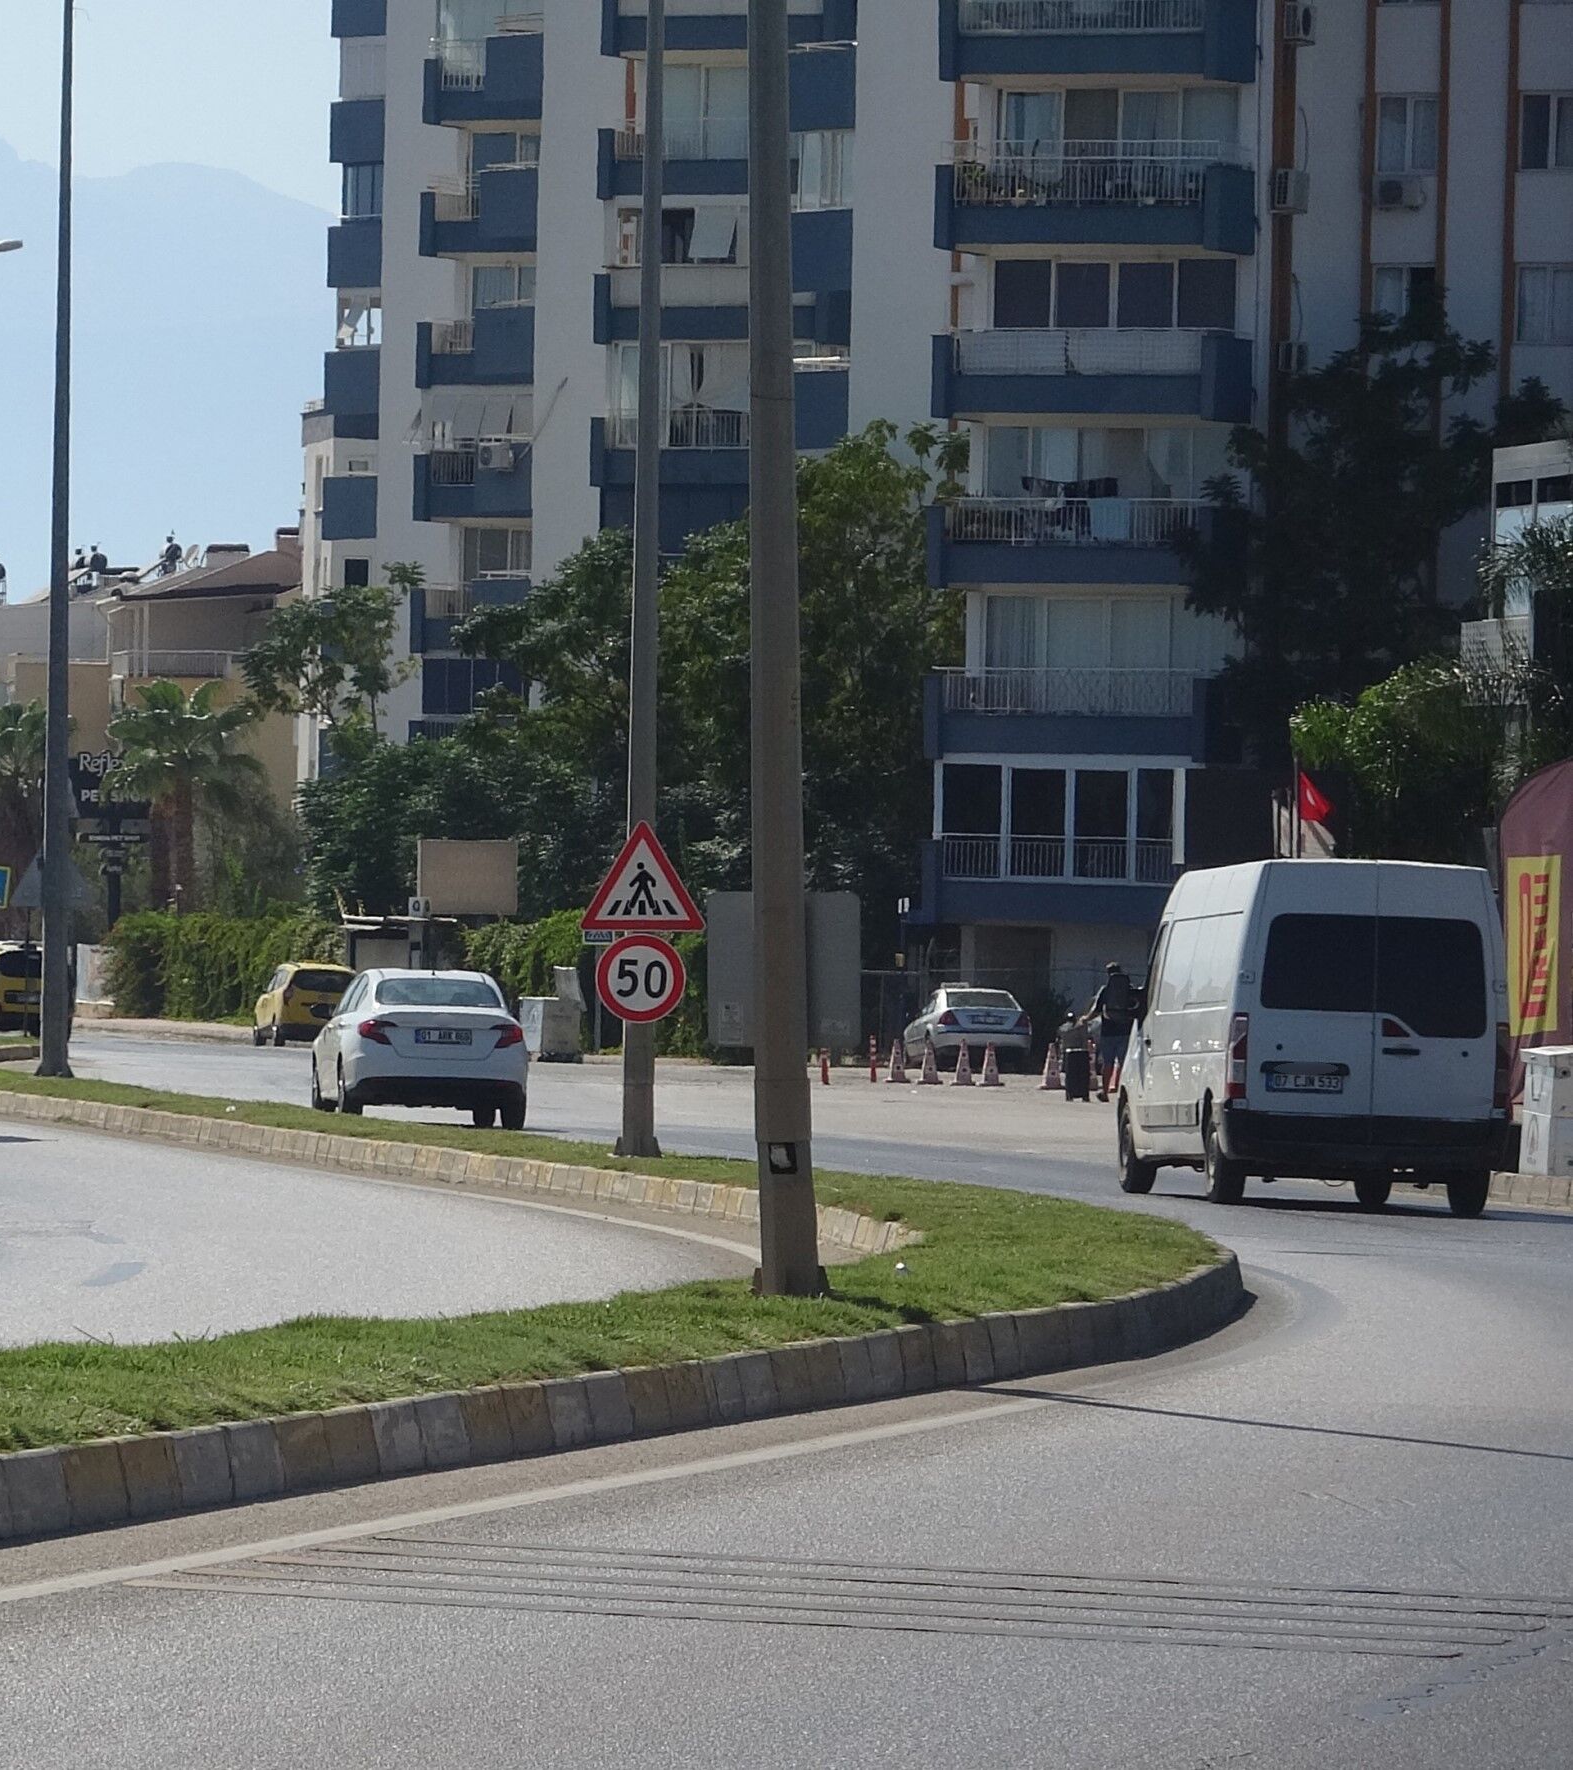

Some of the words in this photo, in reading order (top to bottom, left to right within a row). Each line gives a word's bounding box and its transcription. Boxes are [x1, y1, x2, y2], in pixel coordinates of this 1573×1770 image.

[1519, 872, 1549, 1019] PIRELLI
[616, 958, 667, 999] 50
[1318, 1077, 1339, 1089] 533
